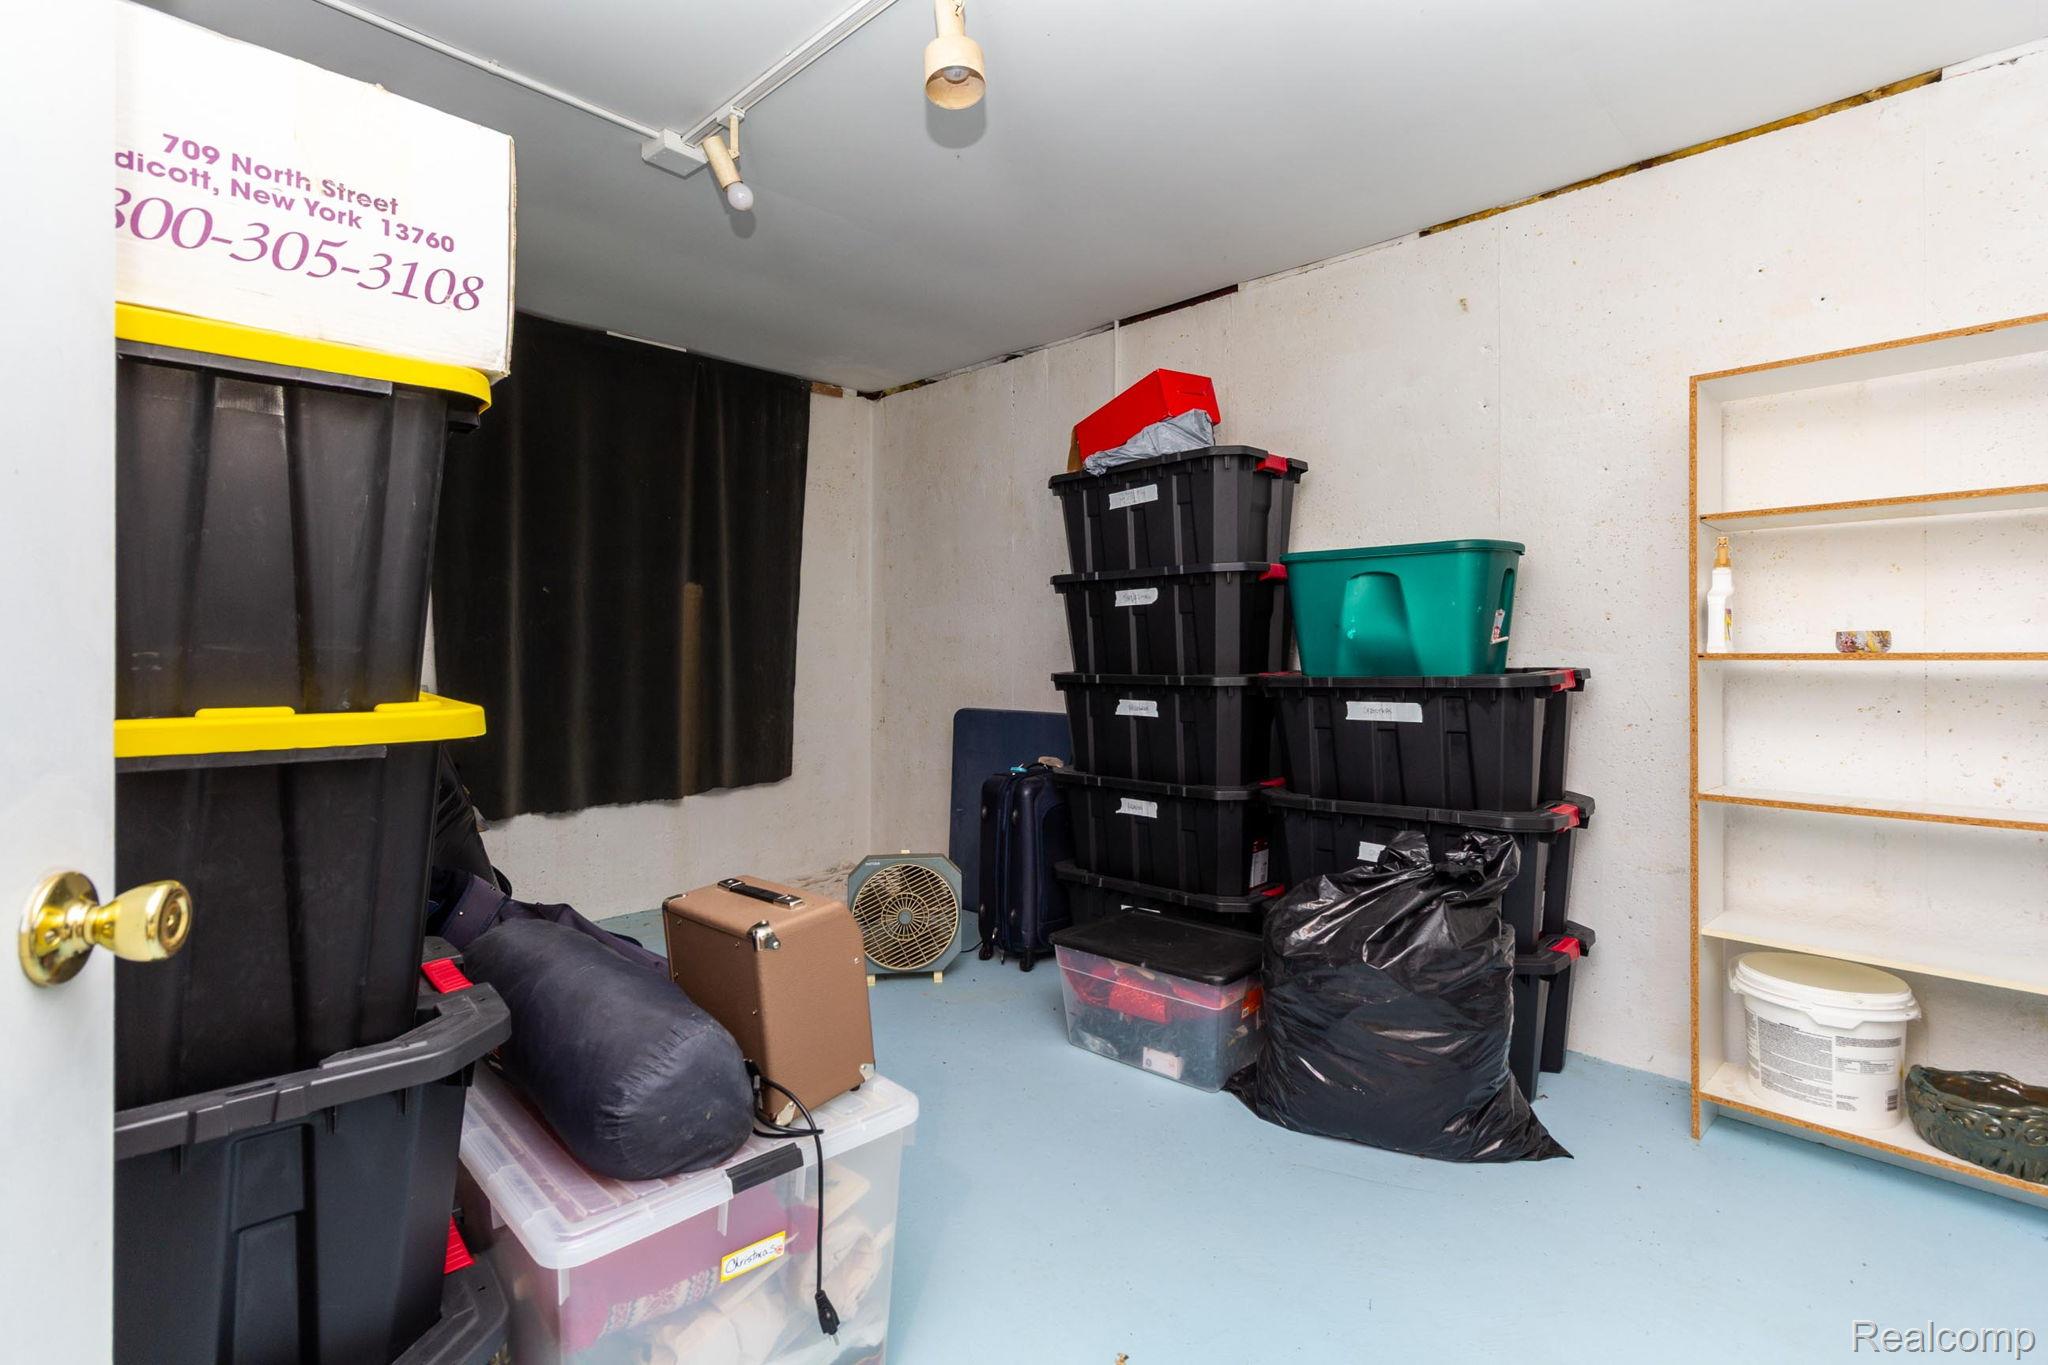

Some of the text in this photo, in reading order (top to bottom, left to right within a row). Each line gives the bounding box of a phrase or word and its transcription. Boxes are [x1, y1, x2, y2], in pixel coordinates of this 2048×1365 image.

[115, 151, 455, 252] dicott, New York 13760
[163, 133, 399, 215] 709 North Street
[725, 1242, 776, 1274] Christmas
